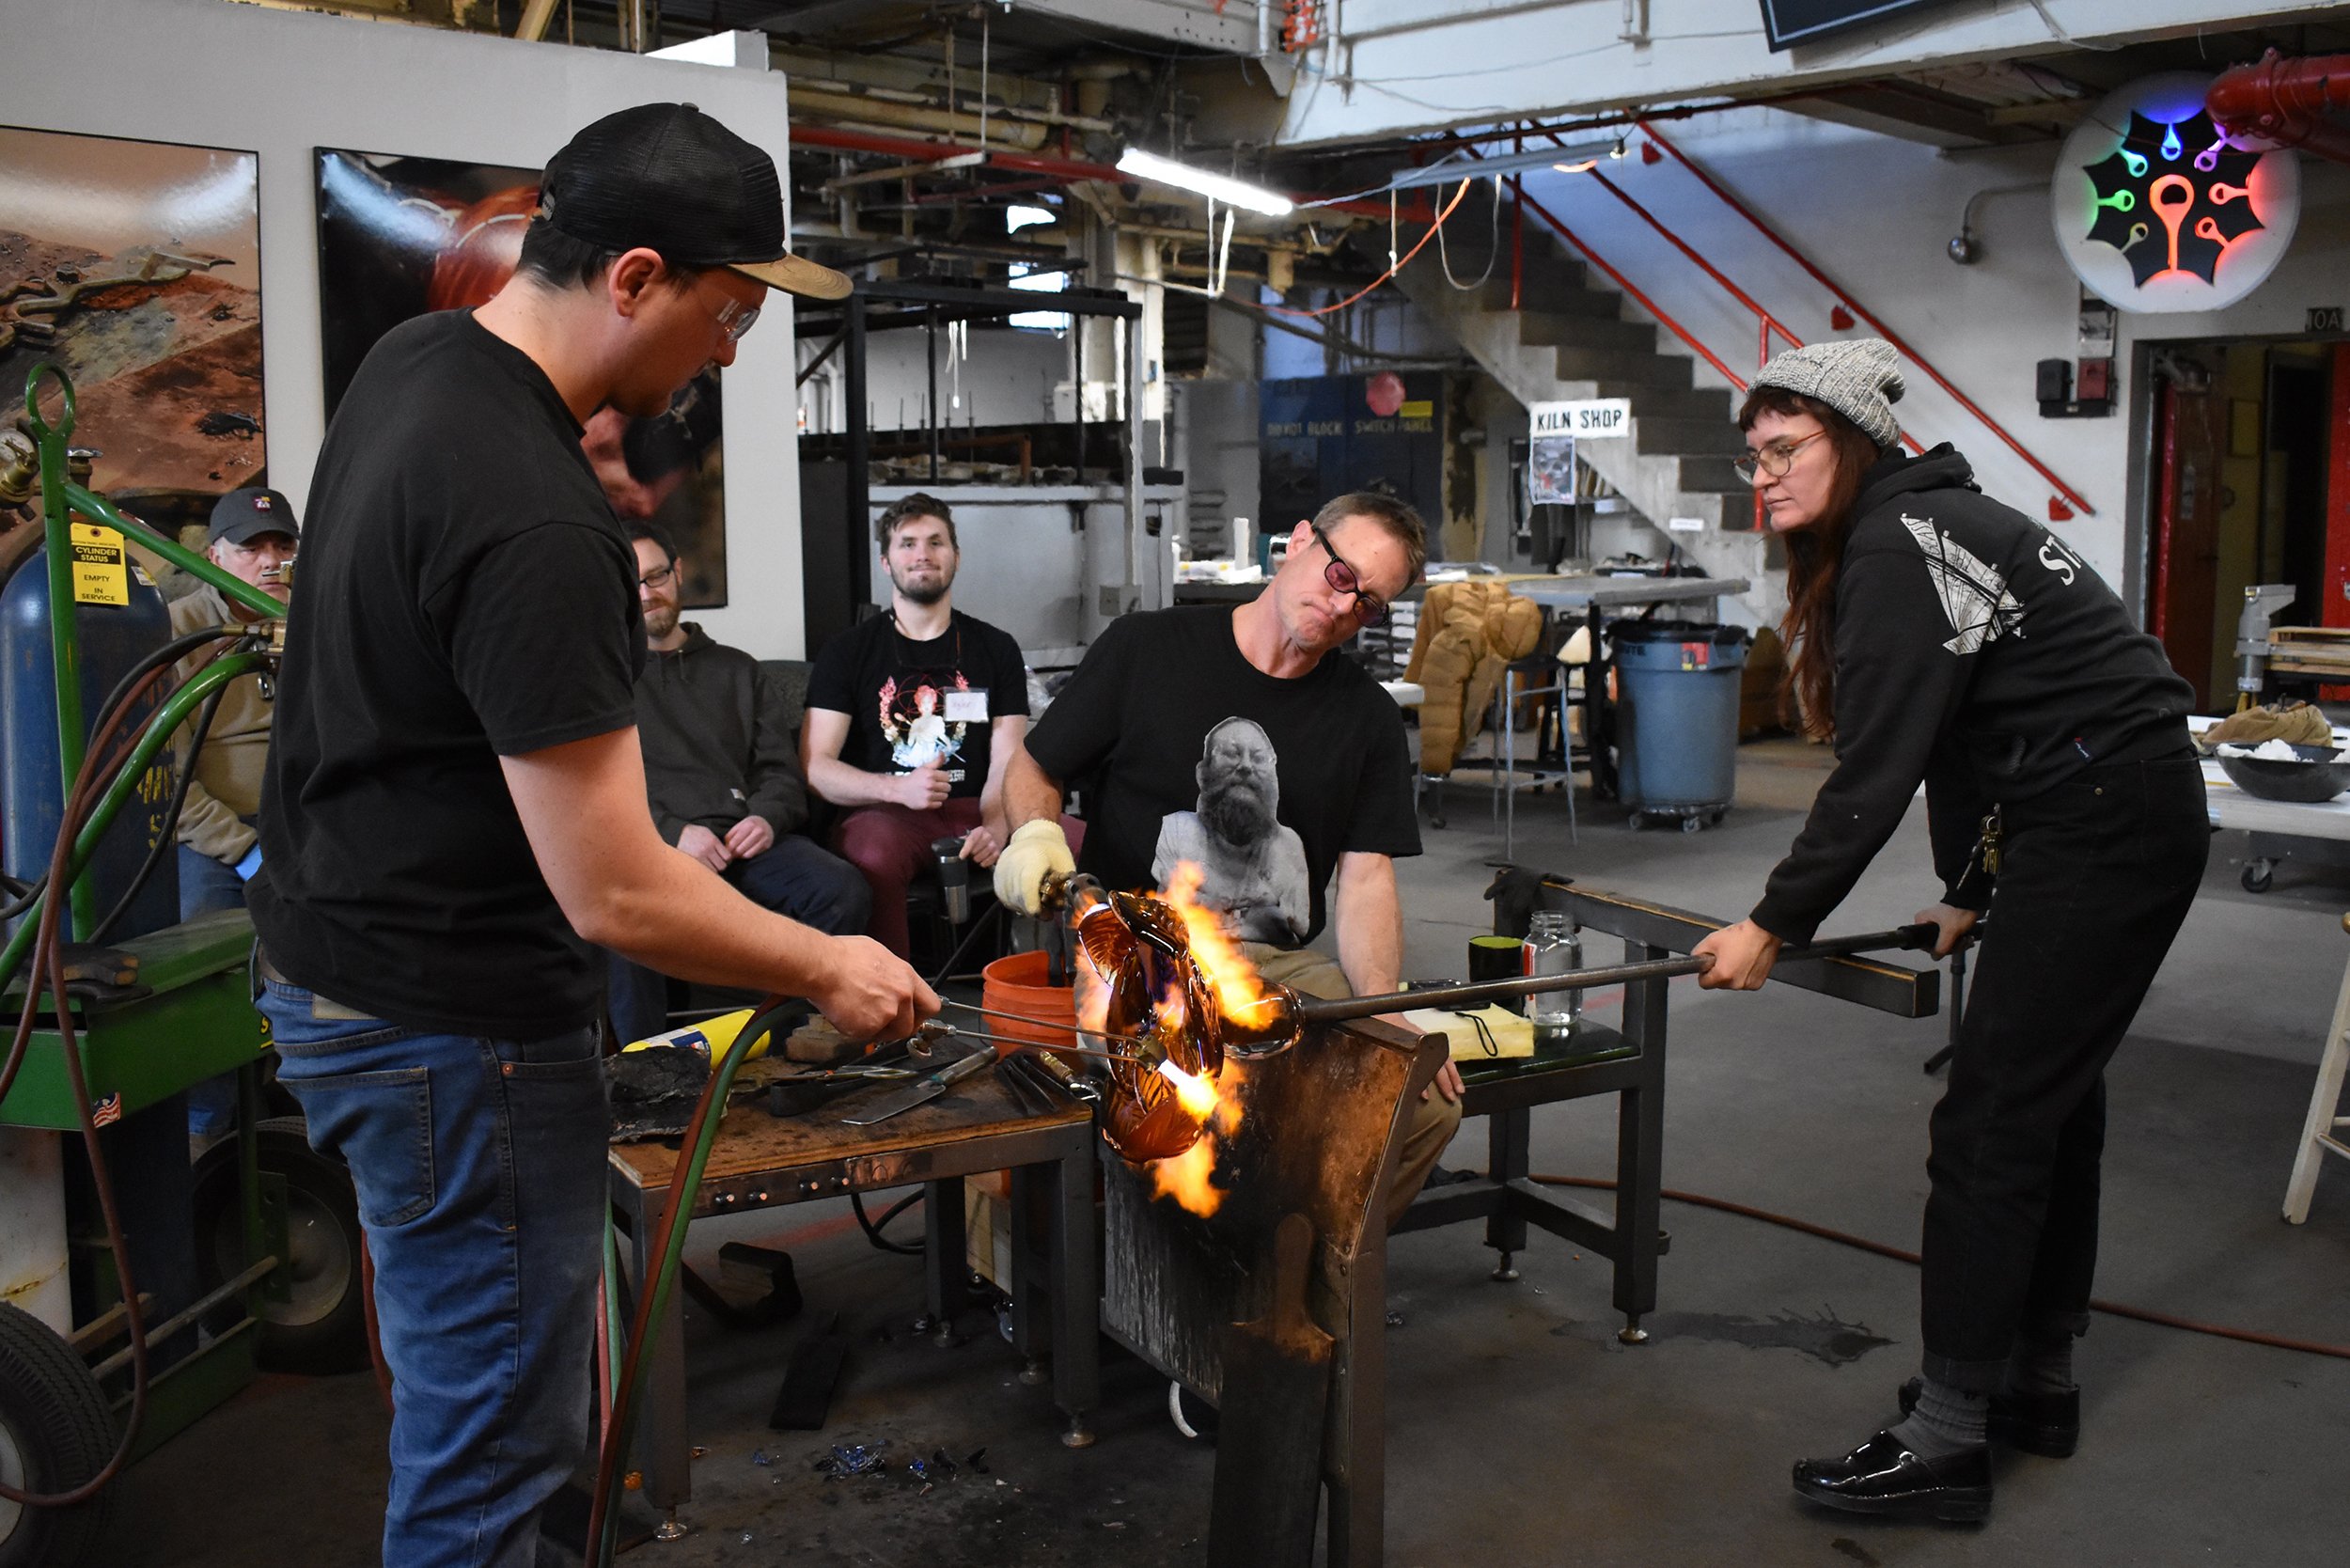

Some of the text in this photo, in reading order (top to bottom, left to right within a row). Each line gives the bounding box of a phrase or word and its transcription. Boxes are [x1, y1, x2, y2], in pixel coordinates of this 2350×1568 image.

[1537, 409, 1622, 431] KILN SHOP
[75, 546, 118, 557] CYLINDER
[81, 593, 116, 602] SERVICE
